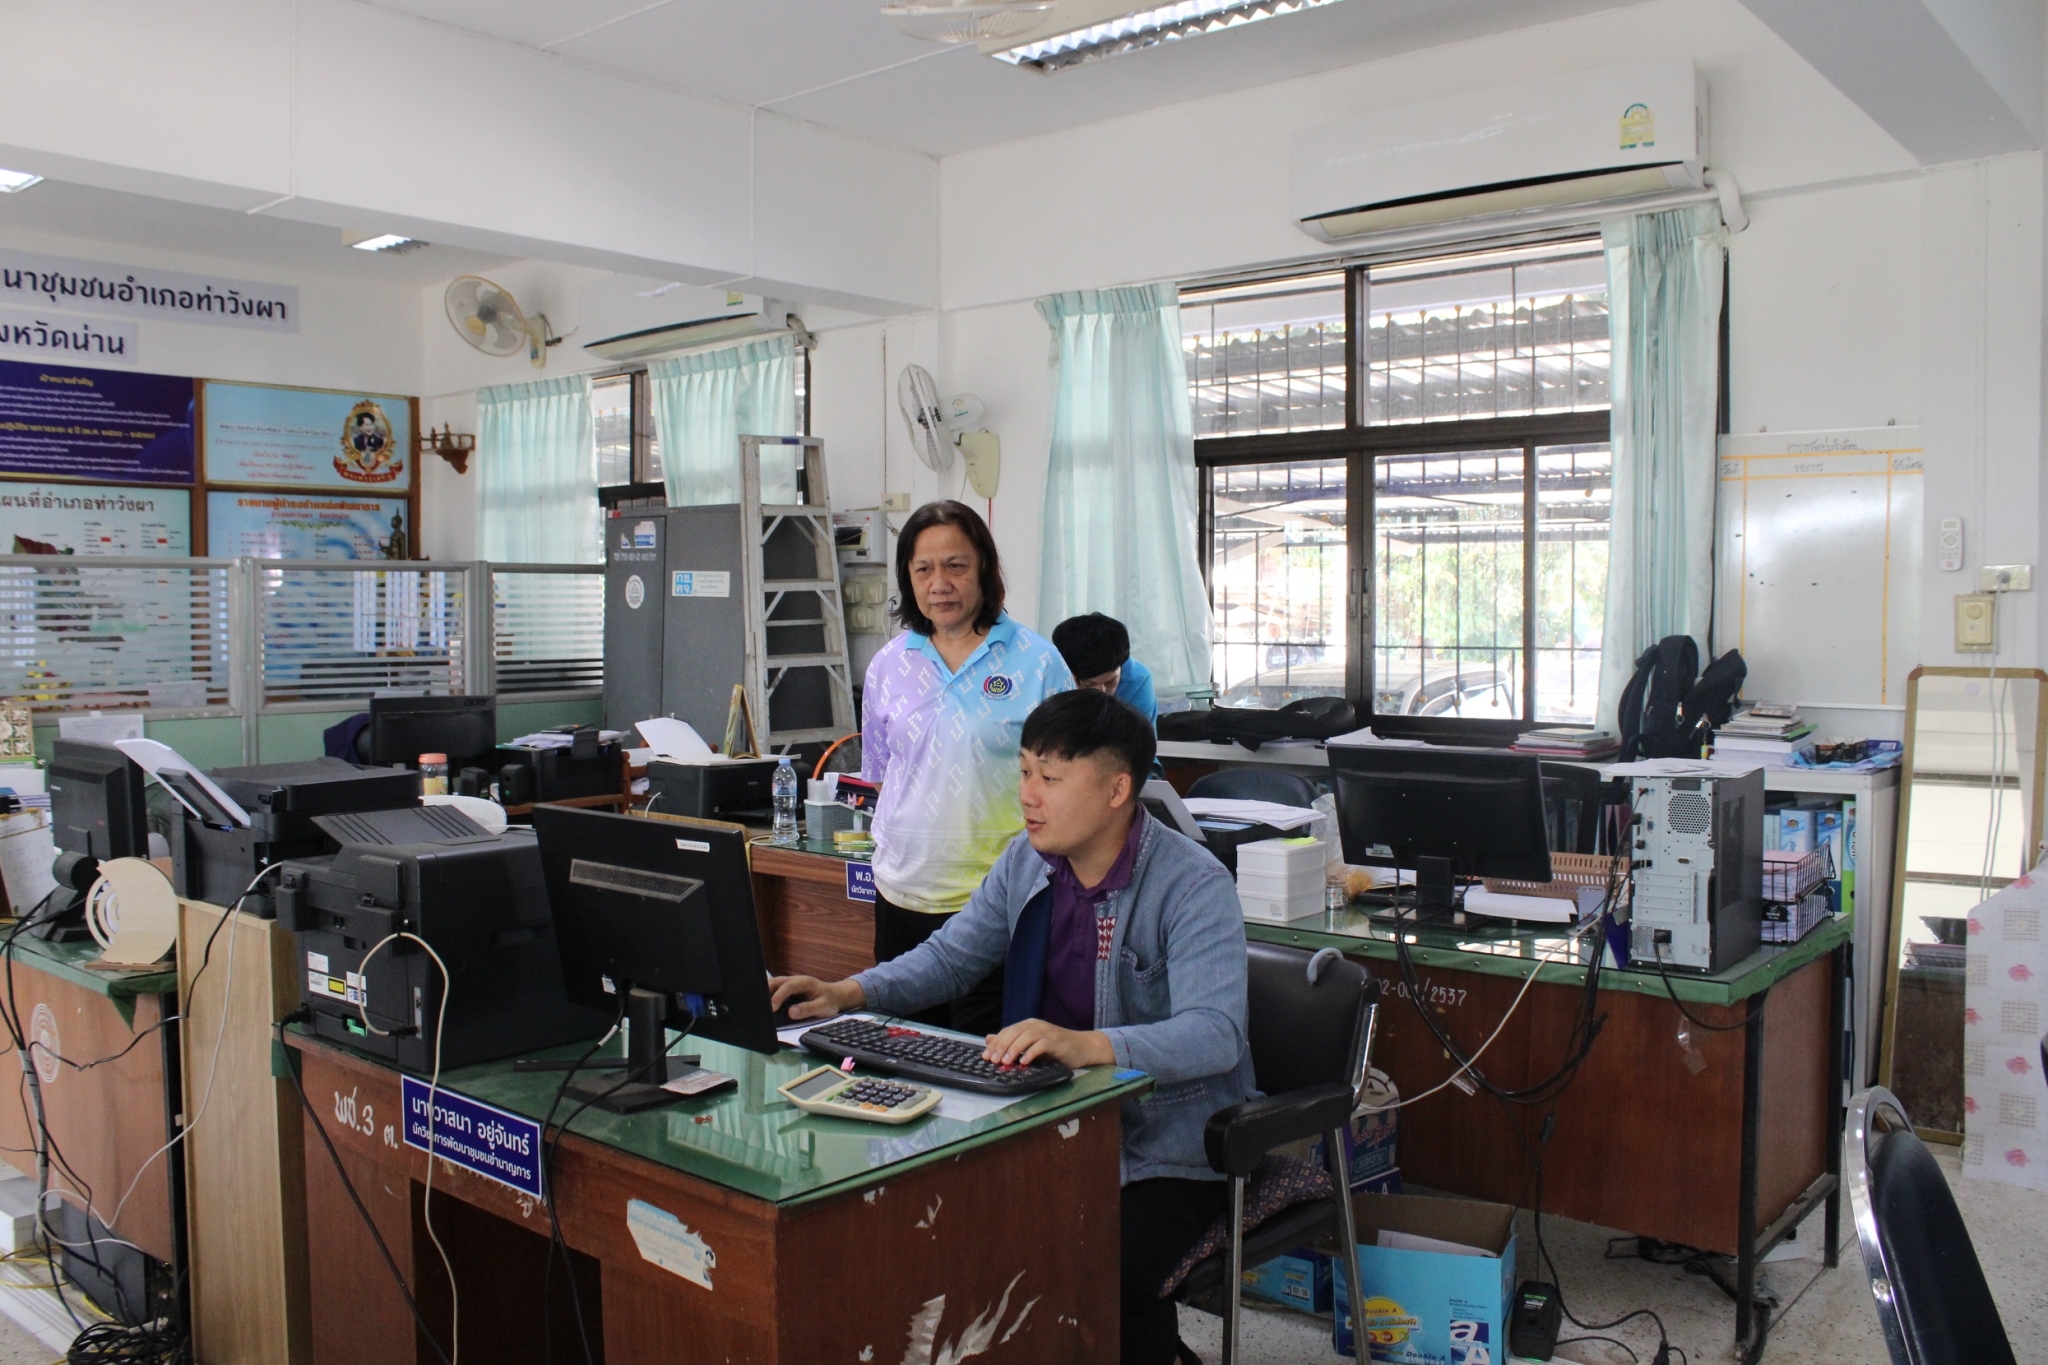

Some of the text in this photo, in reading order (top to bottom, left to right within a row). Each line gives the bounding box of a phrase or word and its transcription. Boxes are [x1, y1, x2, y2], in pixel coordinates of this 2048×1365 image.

[3, 268, 287, 320] นาชุมชนอำเภอท่าวังผา
[0, 488, 154, 511] ผนที่อำเภอท่าวังผา
[412, 1121, 531, 1180] นักวิชการพัฒนาชุมชนชำนาญการ
[477, 1120, 530, 1156] อยู่จันทร์
[1406, 1351, 1437, 1360] Double
